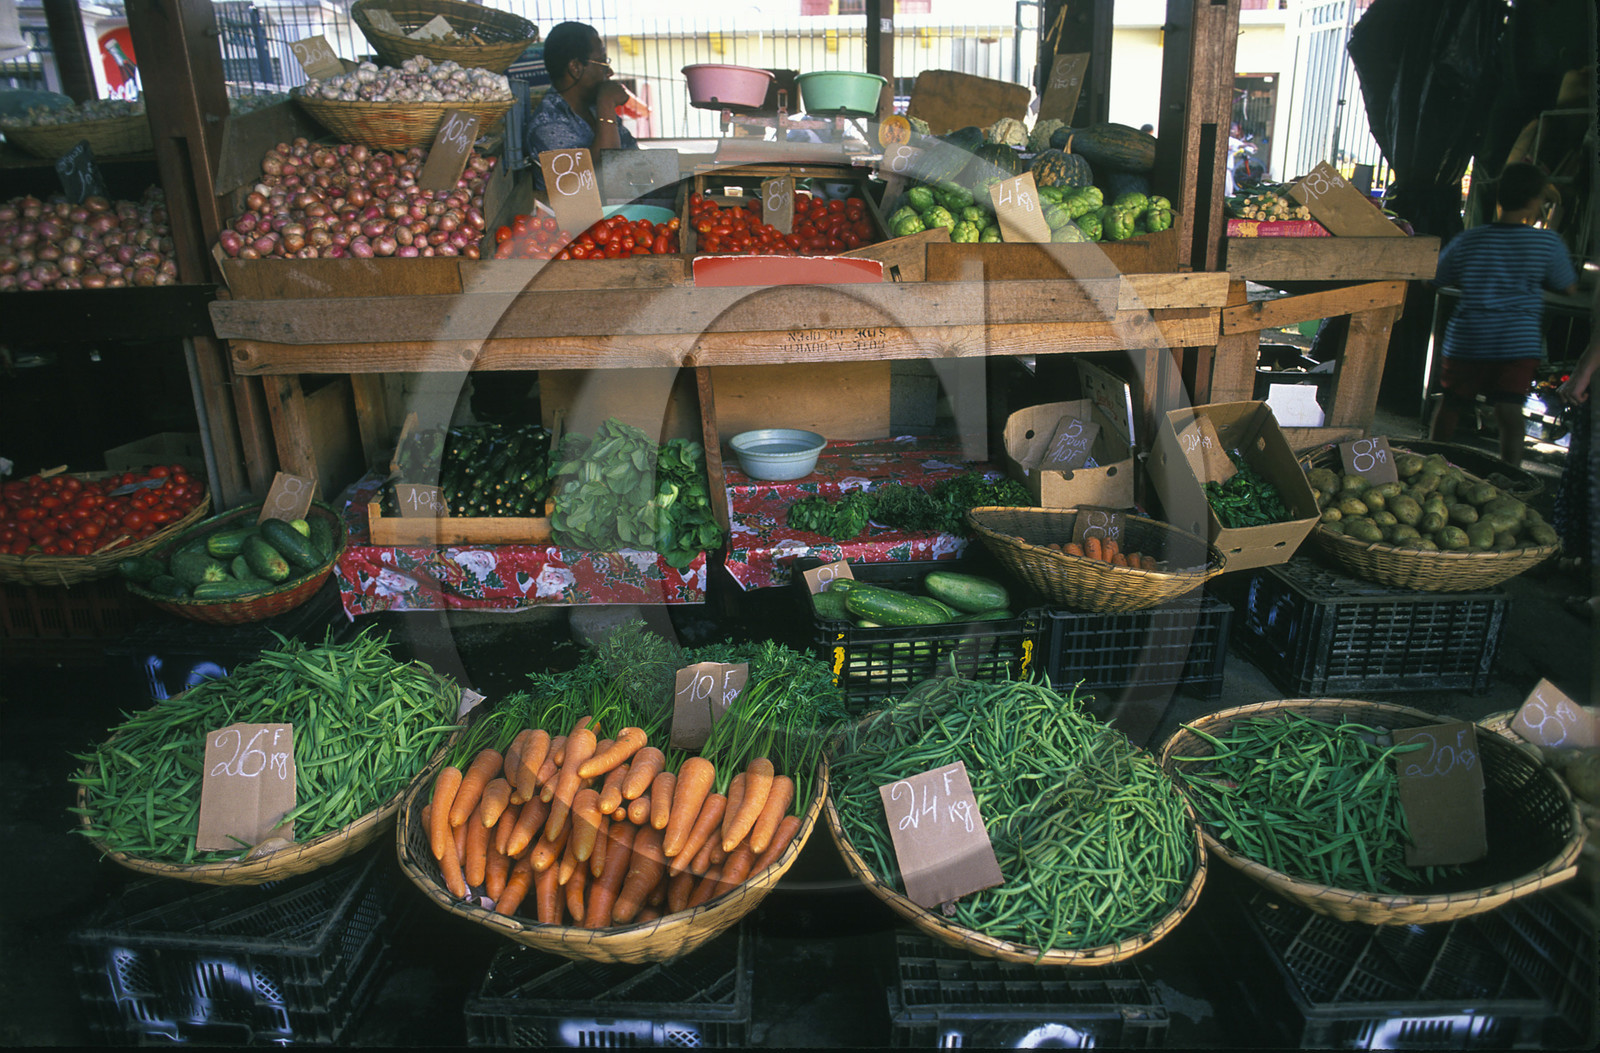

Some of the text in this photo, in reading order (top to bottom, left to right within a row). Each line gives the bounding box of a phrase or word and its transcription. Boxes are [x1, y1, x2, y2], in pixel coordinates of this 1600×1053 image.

[440, 113, 464, 144] 10
[463, 117, 475, 133] F
[551, 153, 582, 196] 8
[574, 151, 583, 166] F
[892, 145, 913, 172] 8
[767, 181, 783, 212] 8
[999, 183, 1012, 206] 4
[1014, 177, 1023, 192] F
[1301, 172, 1329, 203] 18
[1319, 166, 1330, 179] F
[1063, 418, 1083, 438] 5
[1352, 439, 1376, 472] 8
[1372, 437, 1380, 448] F
[274, 477, 303, 512] 8
[407, 487, 432, 512] 10
[1110, 513, 1119, 524] F
[833, 563, 840, 578] F
[676, 669, 715, 703] 10
[723, 669, 737, 690] F
[1522, 703, 1567, 747] 8
[210, 729, 270, 777] 26
[272, 728, 285, 746] F
[1405, 732, 1455, 777] 20
[1456, 729, 1467, 748] F
[891, 781, 938, 831] 24
[942, 768, 959, 796] F
